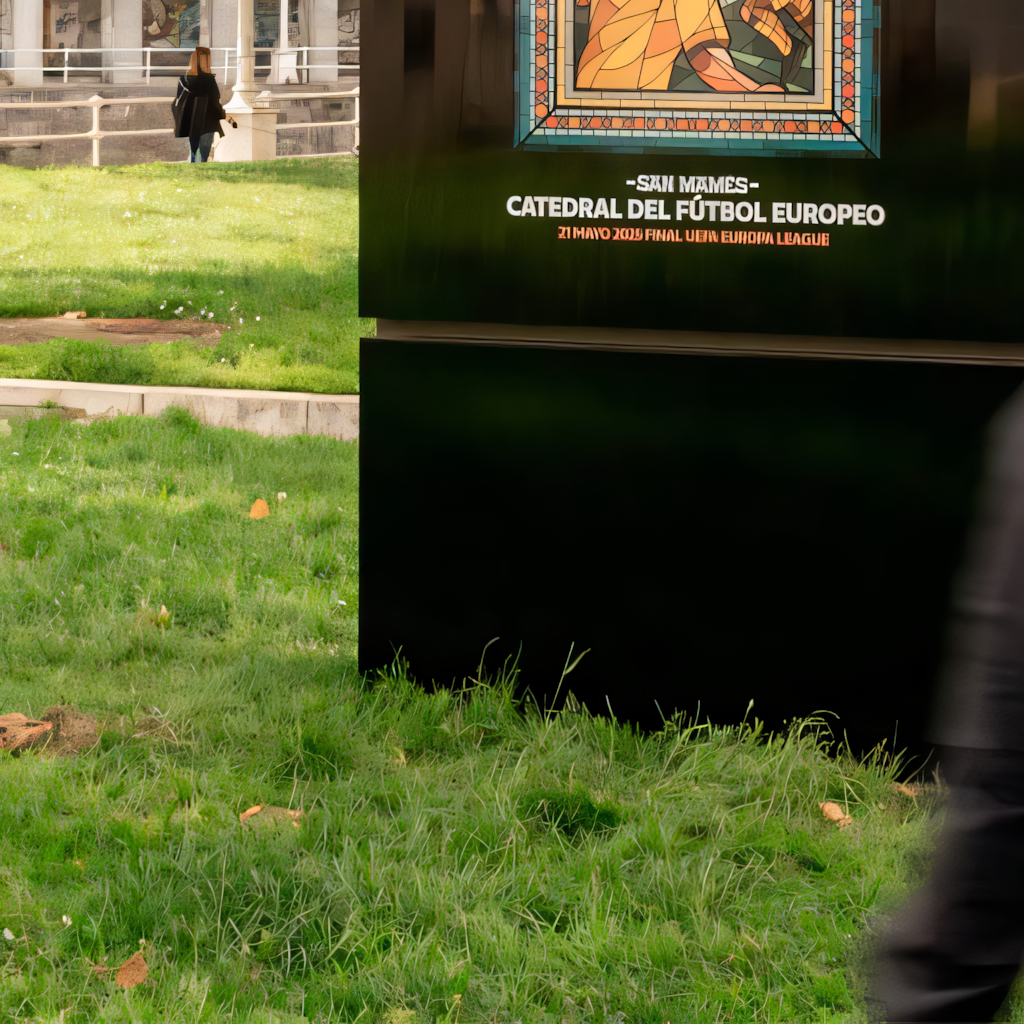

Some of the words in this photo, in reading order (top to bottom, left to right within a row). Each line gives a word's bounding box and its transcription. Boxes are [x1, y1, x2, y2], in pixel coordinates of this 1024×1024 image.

[507, 196, 622, 219] CATEDRAL
[628, 199, 671, 220] DEL
[676, 193, 767, 222] FÚTBOL
[772, 202, 885, 226] EUROPEO
[573, 227, 611, 240] MAYO
[645, 229, 683, 242] FINAL
